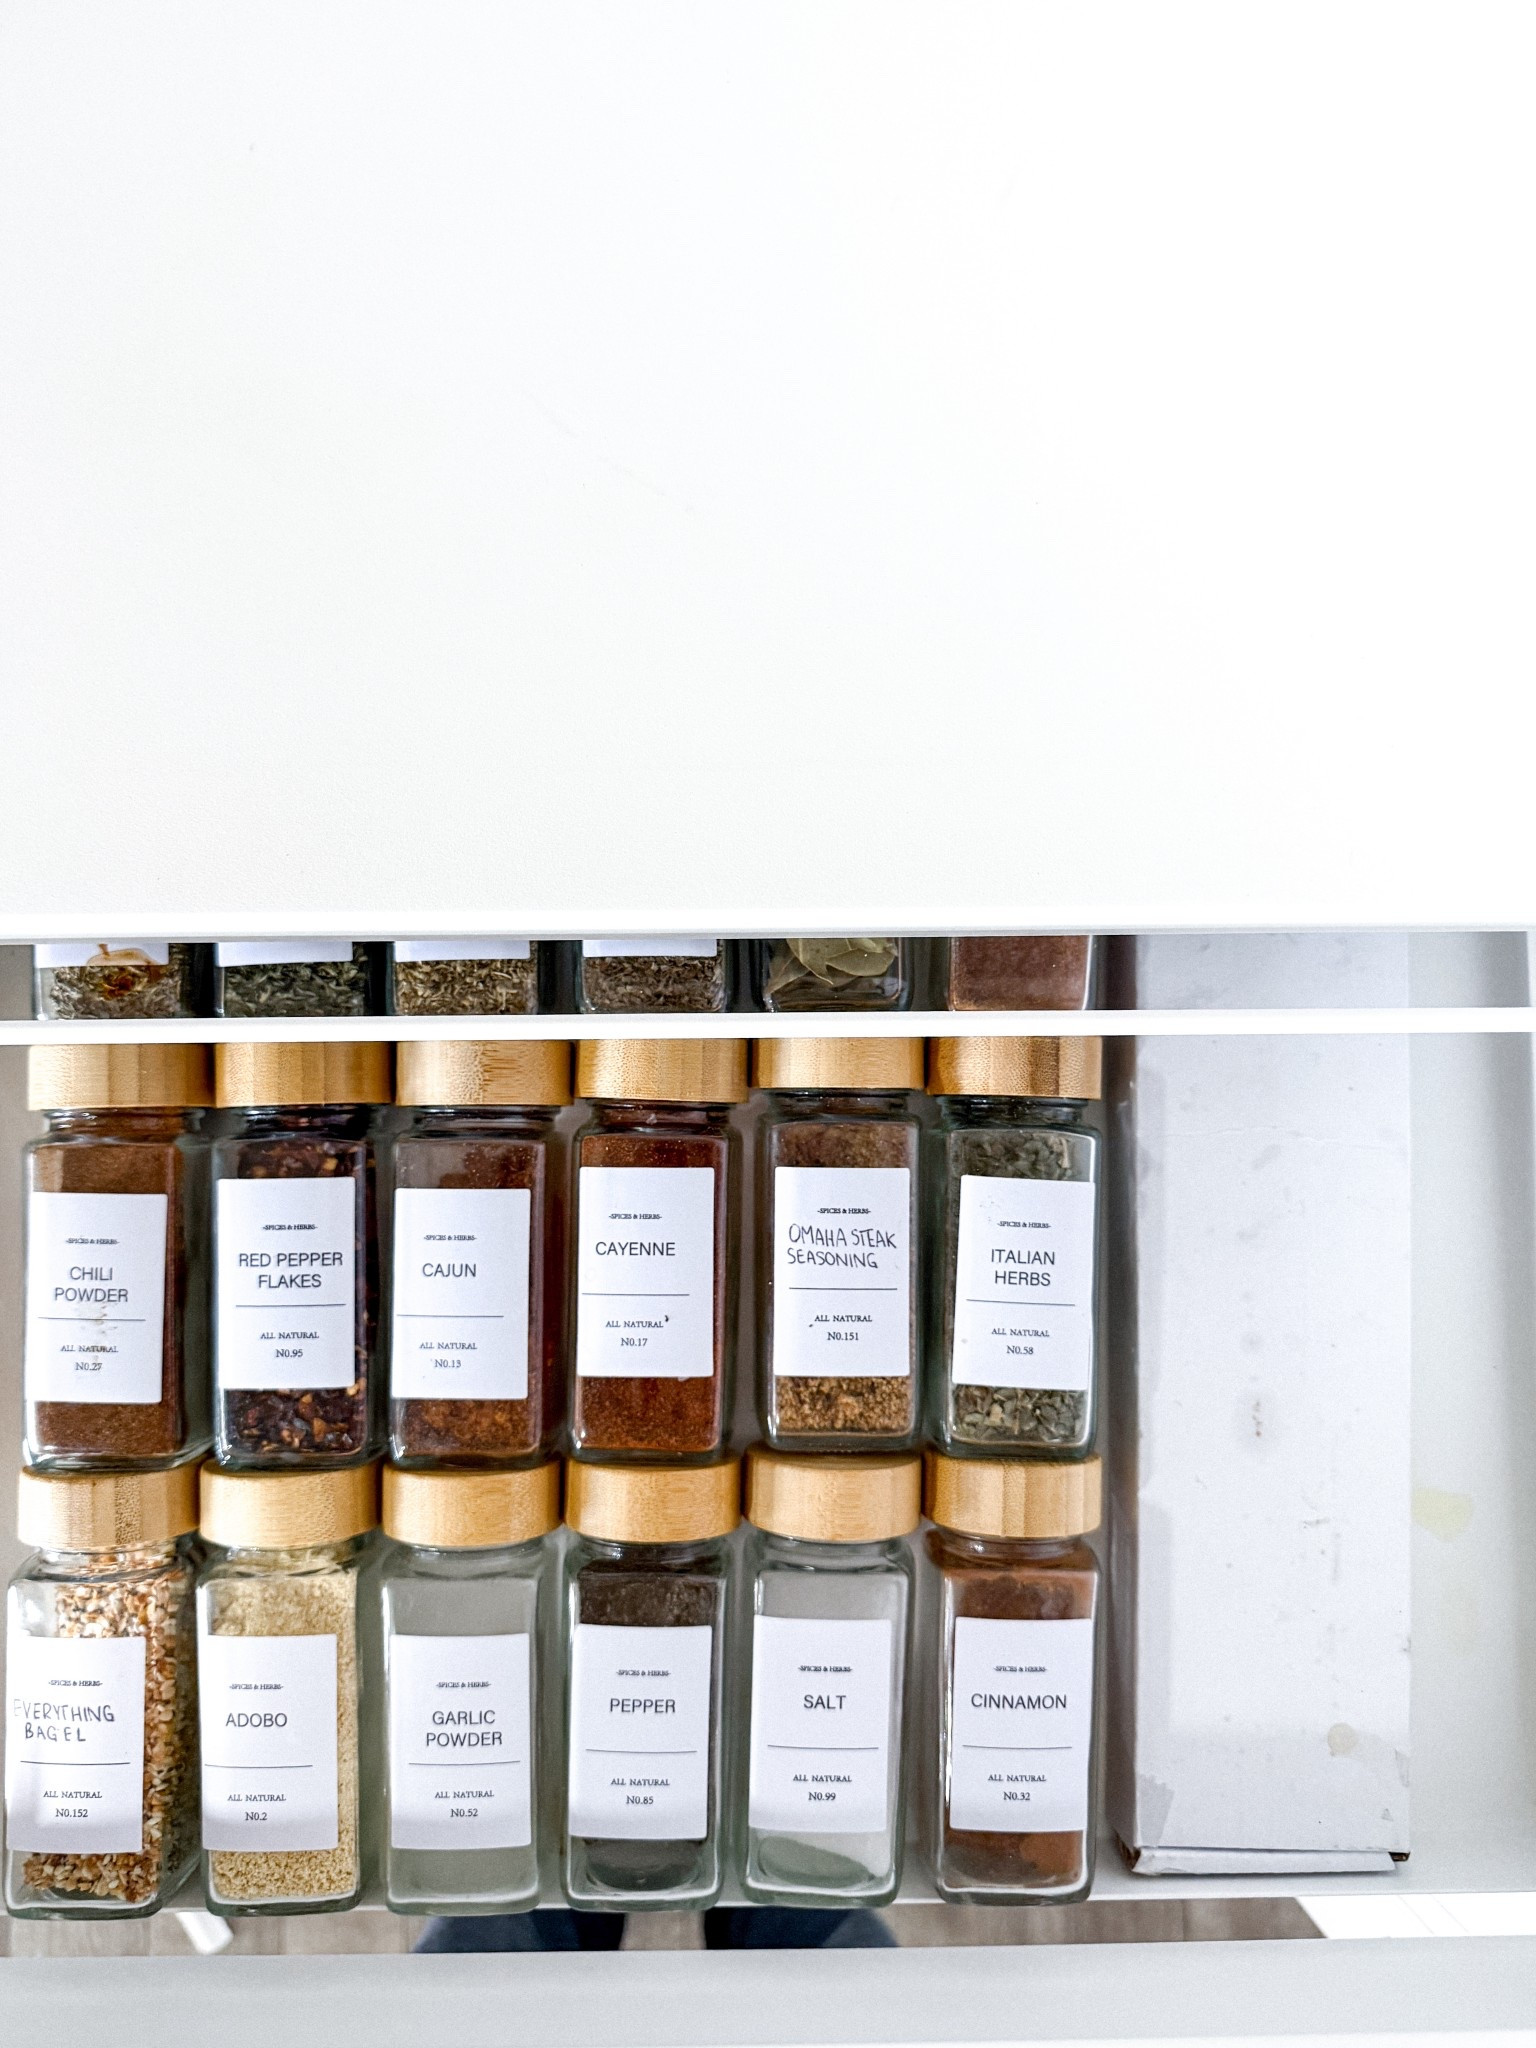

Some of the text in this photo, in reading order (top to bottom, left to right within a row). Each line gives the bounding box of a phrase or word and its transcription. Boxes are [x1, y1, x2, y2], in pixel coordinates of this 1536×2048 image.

[787, 1222, 898, 1250] OMAHA STEAK
[594, 1241, 676, 1257] CAYENNE
[990, 1248, 1056, 1266] ITALIAN
[238, 1251, 344, 1268] RED PEPPER
[786, 1246, 879, 1270] SEASONING
[68, 1265, 114, 1282] CHILI
[421, 1262, 477, 1279] CAJUN
[994, 1269, 1051, 1287] HERBS
[257, 1273, 323, 1290] FLAKES
[53, 1286, 129, 1304] POWDER
[604, 1319, 665, 1329] ALL NATURAL
[813, 1314, 874, 1323] ALL NATURAL
[259, 1331, 320, 1341] ALL NATURAL
[990, 1327, 1051, 1338] ALL NATURAL
[59, 1344, 119, 1354] ALL NATURAL
[418, 1341, 478, 1351] ALL NATURAL
[13, 1697, 116, 1723] EVERYTHING
[609, 1697, 676, 1715] PEPPER
[803, 1693, 847, 1711] SALT
[970, 1692, 1068, 1711] CINNAMON
[224, 1712, 288, 1729] ADOBO
[431, 1709, 496, 1726] GARLIC
[24, 1721, 87, 1743] BAGEL
[425, 1730, 503, 1748] POWDER
[609, 1777, 671, 1787] ALL NATURAL
[792, 1773, 853, 1784] ALL NATURAL
[987, 1773, 1047, 1783] ALL NATURAL
[42, 1790, 103, 1799] ALL NATURAL
[227, 1793, 287, 1803] ALL NATURAL
[434, 1789, 495, 1800] ALL NATURAL
